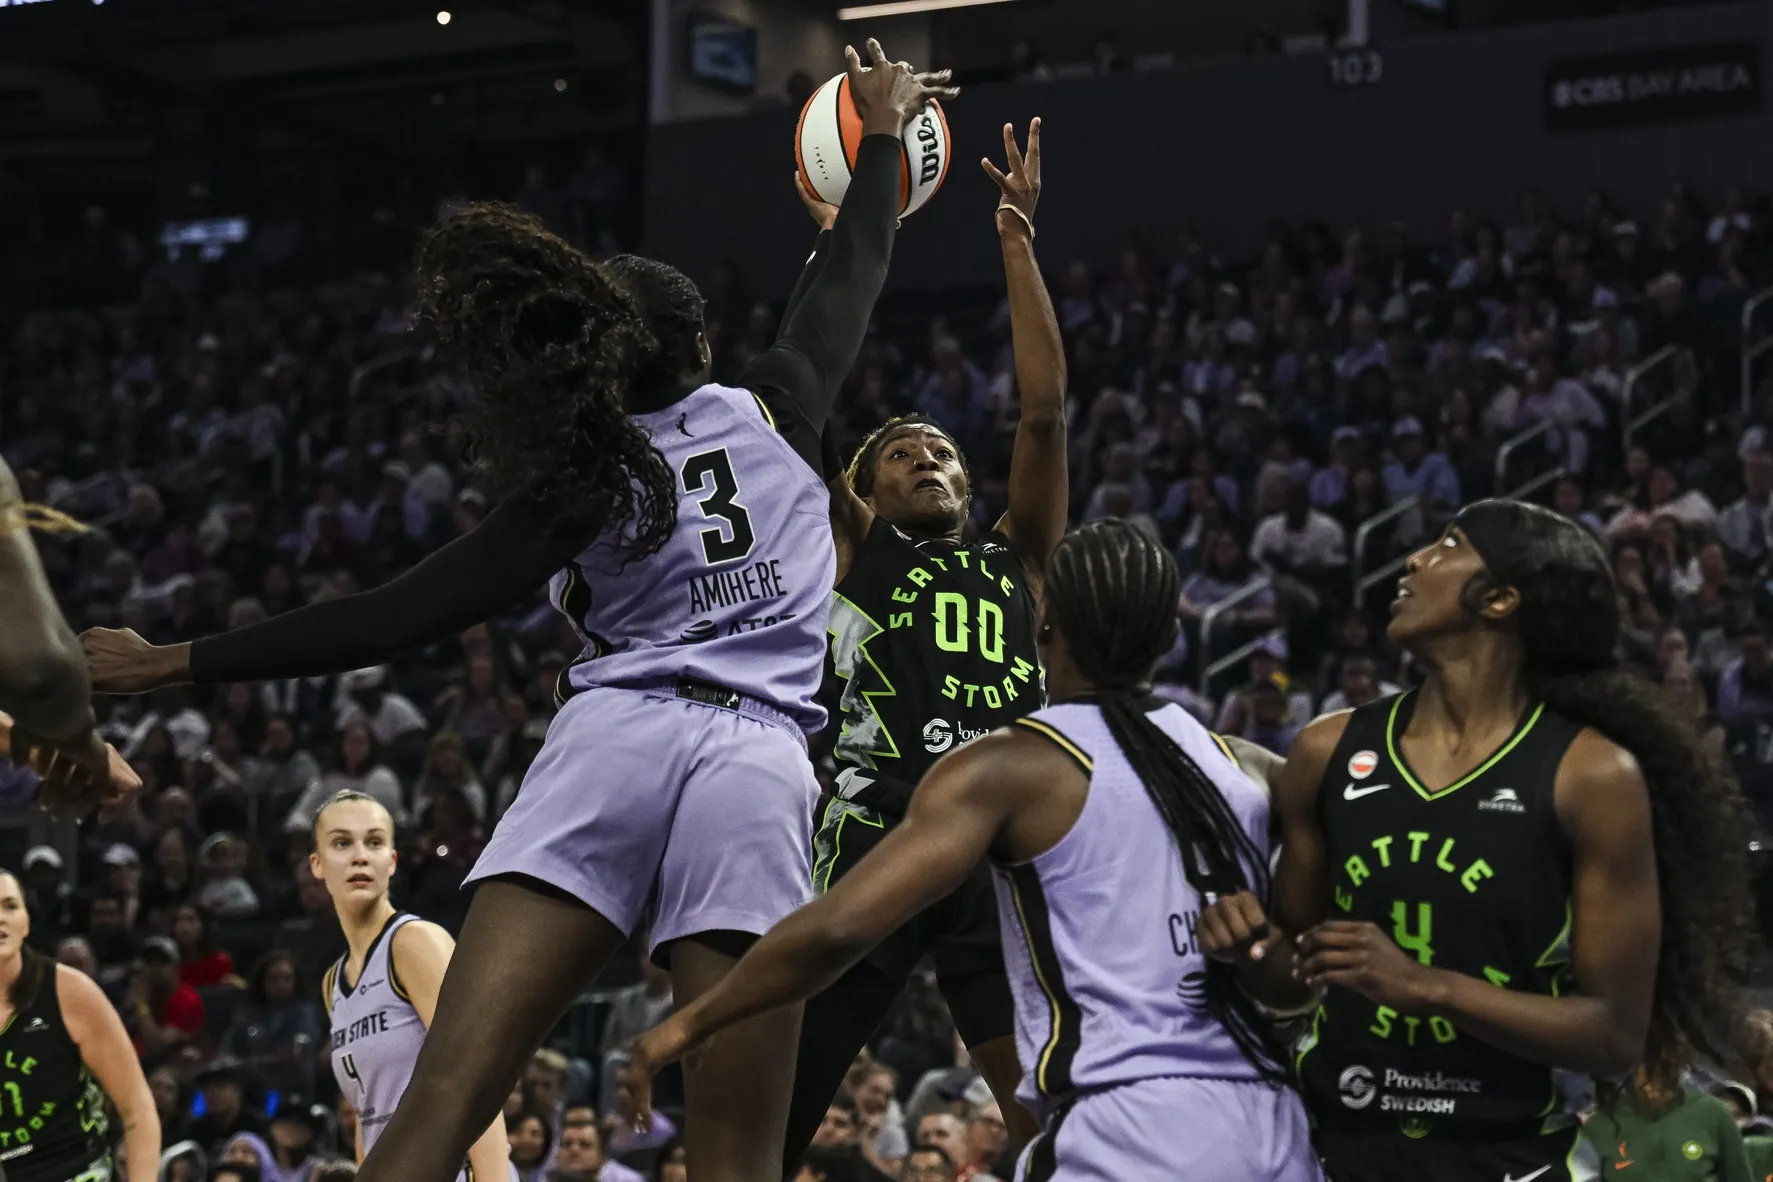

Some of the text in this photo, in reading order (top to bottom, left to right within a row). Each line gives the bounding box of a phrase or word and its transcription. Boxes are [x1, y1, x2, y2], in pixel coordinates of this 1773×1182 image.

[1330, 52, 1382, 85] 103
[918, 112, 939, 187] Wils
[680, 446, 756, 567] 3
[689, 559, 787, 614] AMIHERE
[890, 551, 1014, 628] SEATTLE
[931, 592, 1006, 663] 00
[941, 656, 1034, 708] STORM
[1391, 901, 1435, 966] 4
[349, 1011, 389, 1044] STATE
[341, 1053, 366, 1095] 4
[1384, 1067, 1481, 1092] Providence
[1380, 1094, 1456, 1114] SWEDISH
